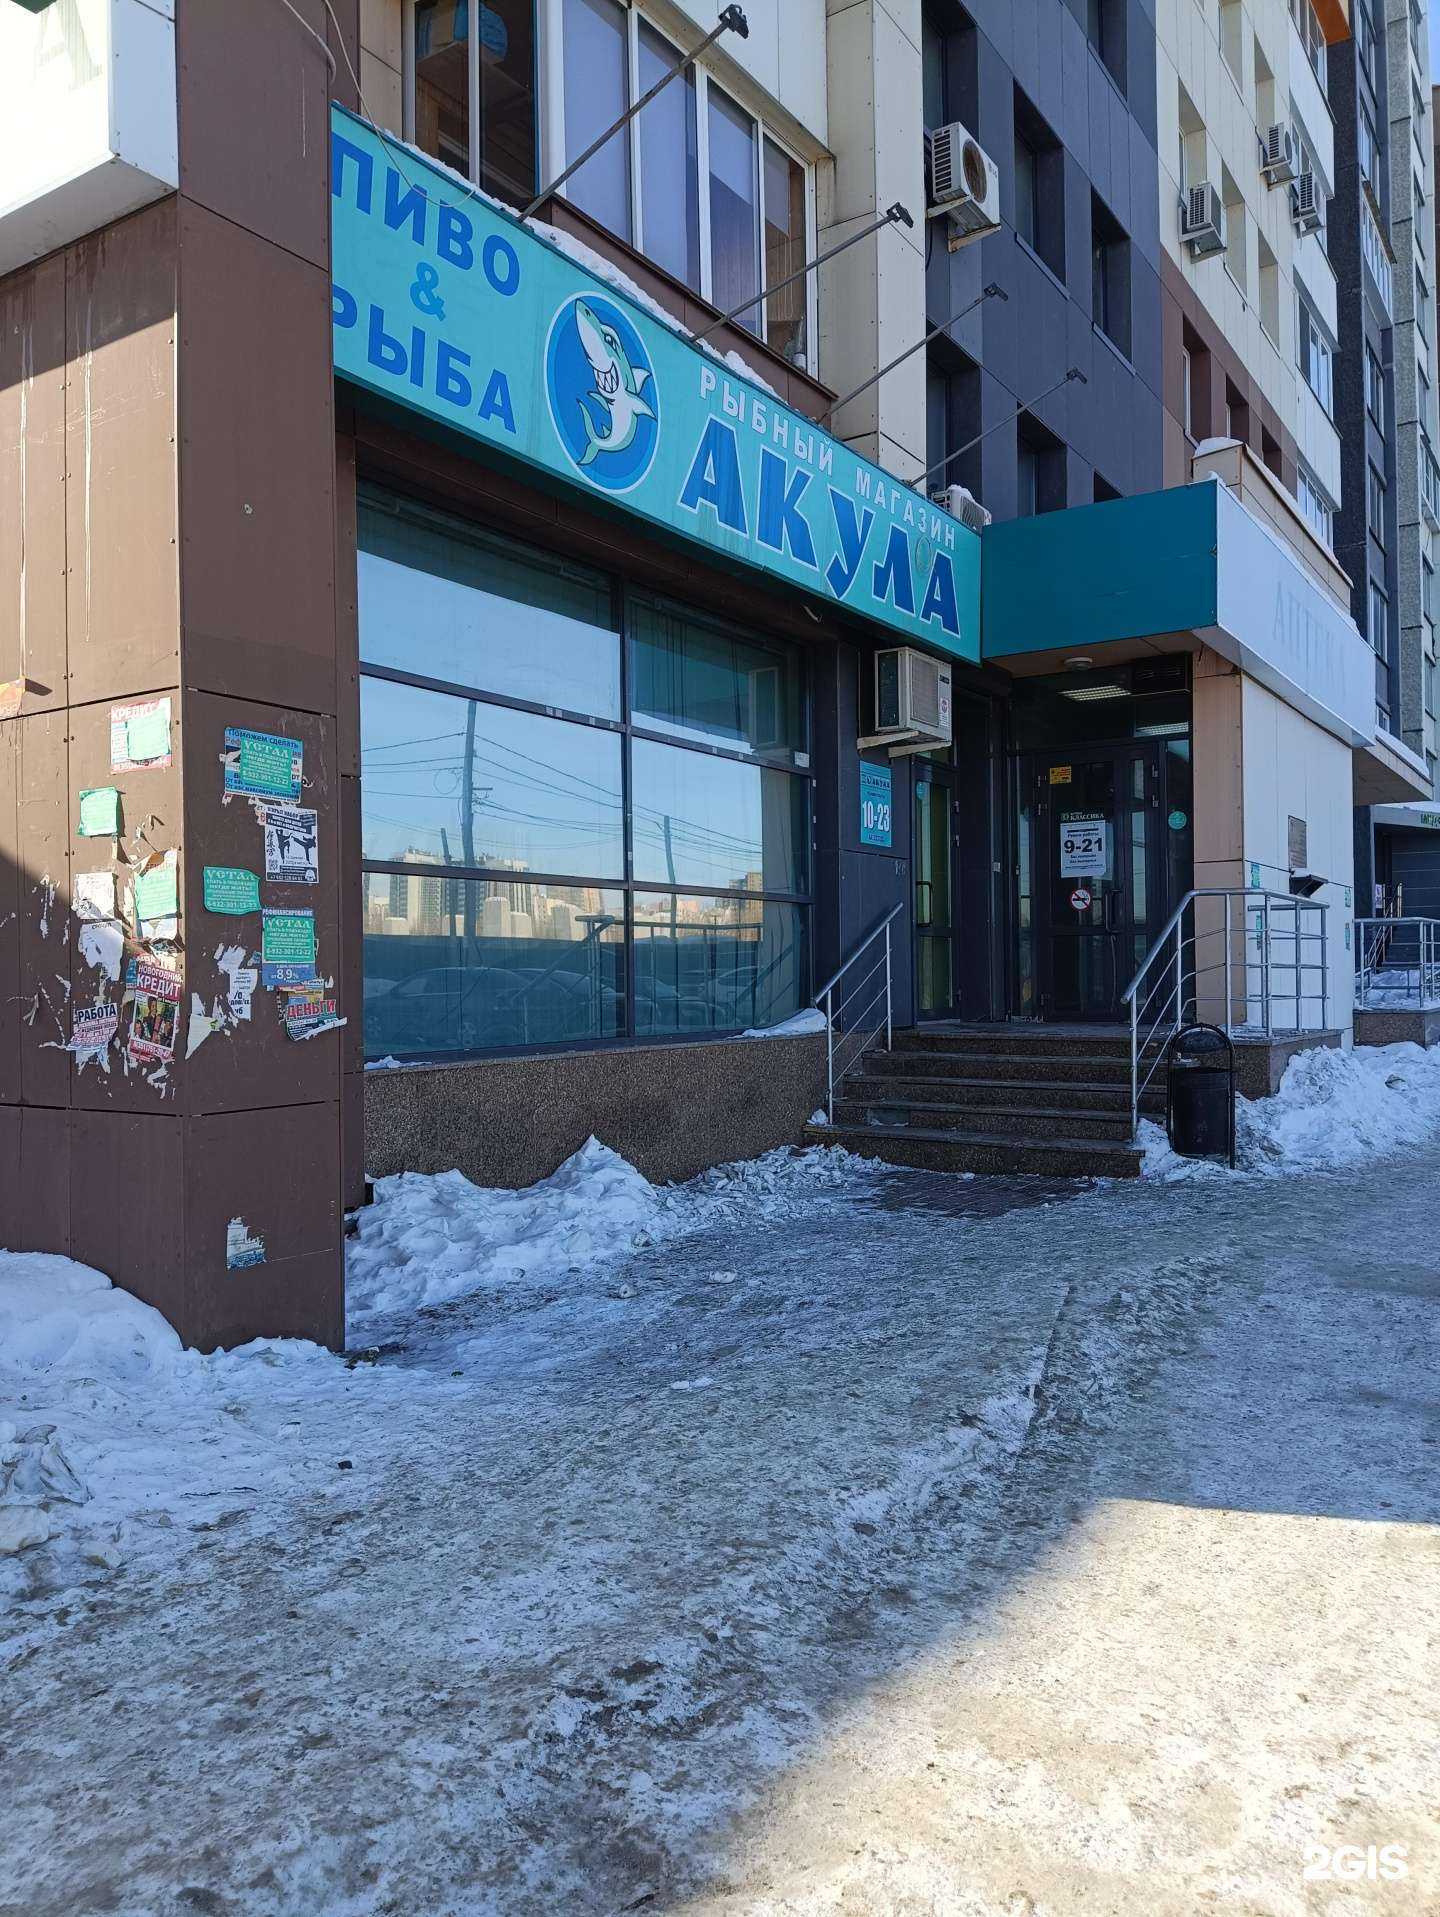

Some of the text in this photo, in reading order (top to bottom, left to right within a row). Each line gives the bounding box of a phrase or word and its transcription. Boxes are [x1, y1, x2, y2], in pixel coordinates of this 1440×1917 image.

[332, 131, 520, 297] ПИВО
[410, 262, 446, 322] &
[699, 366, 955, 551] РЫБНЫЙ МАГАЗИН
[677, 413, 960, 639] АКУЛА
[863, 801, 890, 832] 10-23
[1063, 838, 1103, 854] 9-21
[137, 974, 181, 998] КРЕДИТ
[78, 1004, 116, 1022] РАБОТА
[288, 1000, 336, 1018] ДЕНЬГИ
